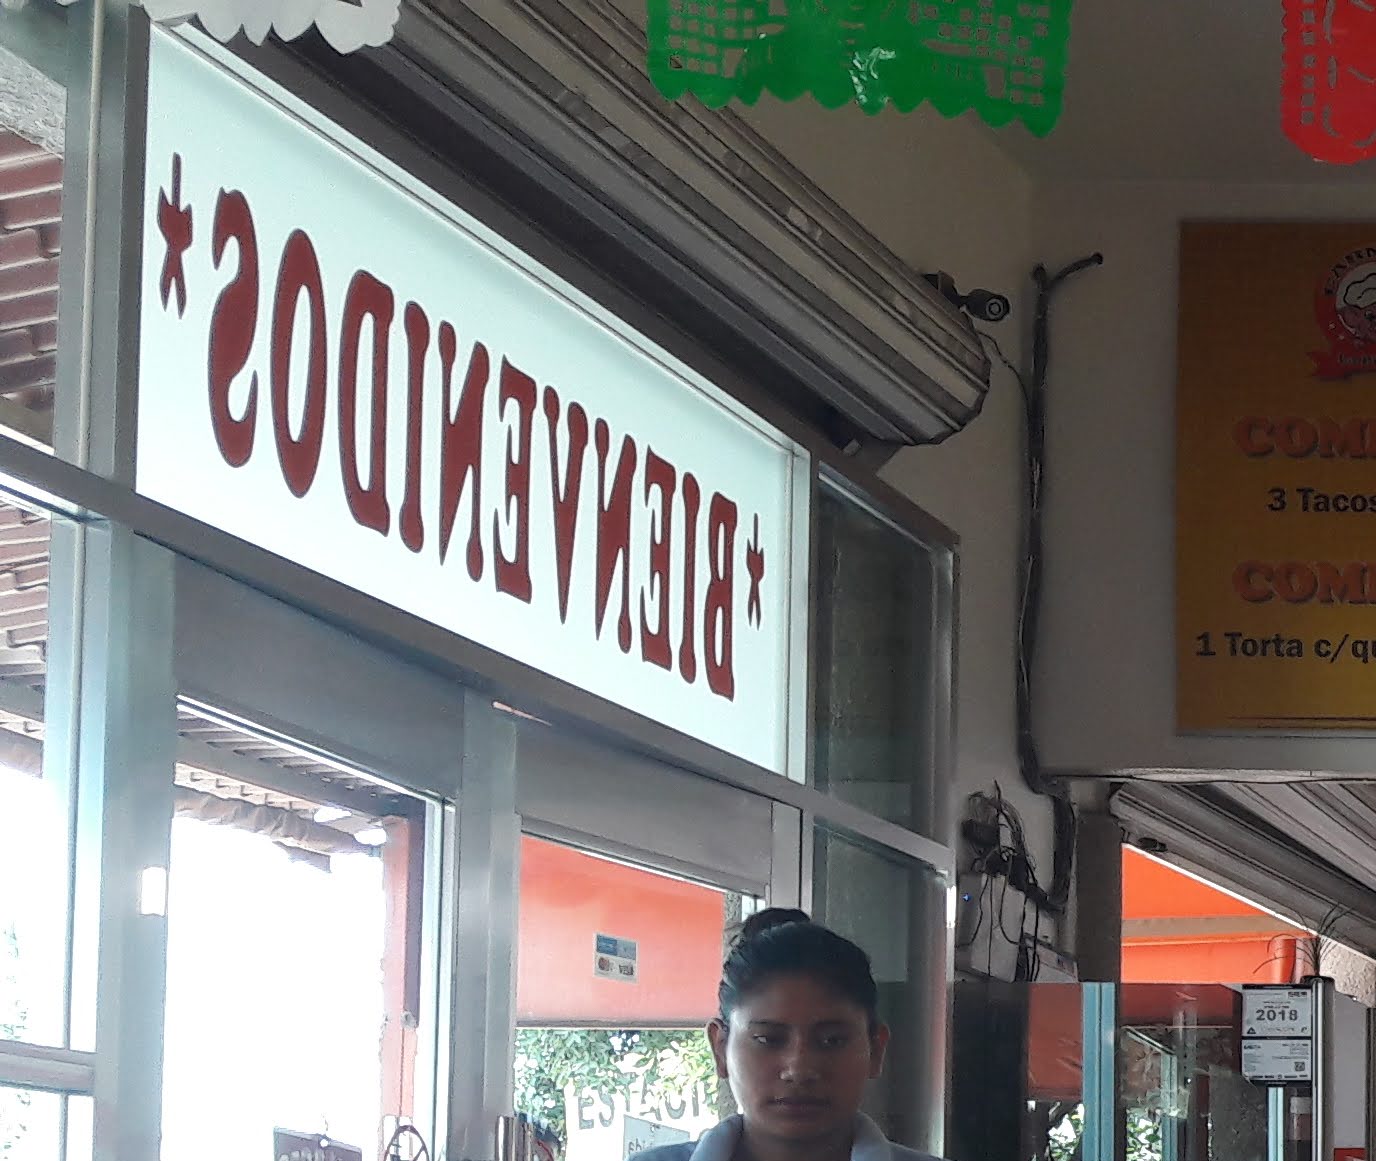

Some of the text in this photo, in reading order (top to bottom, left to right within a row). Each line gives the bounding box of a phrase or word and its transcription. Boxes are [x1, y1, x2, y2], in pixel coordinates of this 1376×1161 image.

[1267, 487, 1288, 513] 3
[1194, 632, 1216, 658] 1
[1223, 631, 1304, 659] Torta
[1255, 1008, 1299, 1022] 2018
